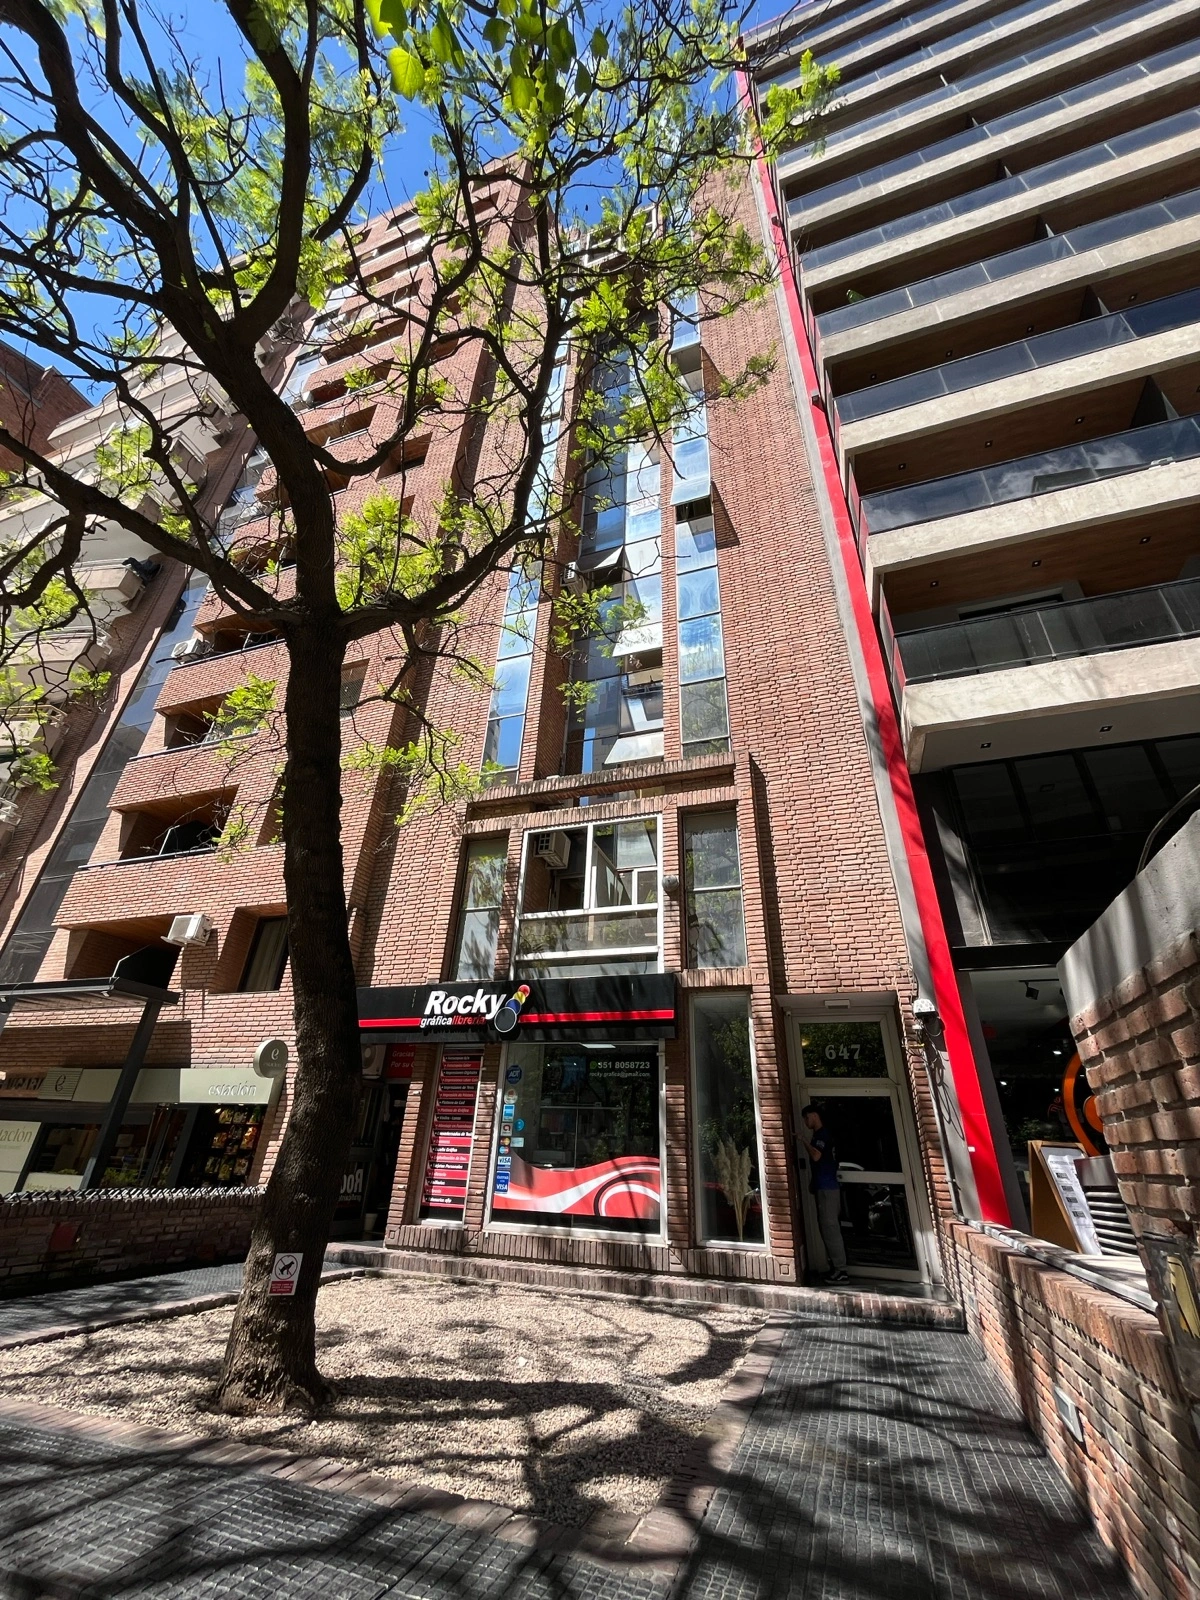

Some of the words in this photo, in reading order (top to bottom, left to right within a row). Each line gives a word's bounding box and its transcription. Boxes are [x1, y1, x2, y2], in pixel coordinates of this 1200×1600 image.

[423, 989, 507, 1020] Rocky
[825, 1044, 861, 1060] 647
[614, 1061, 650, 1069] 8058723
[208, 1081, 257, 1096] estación
